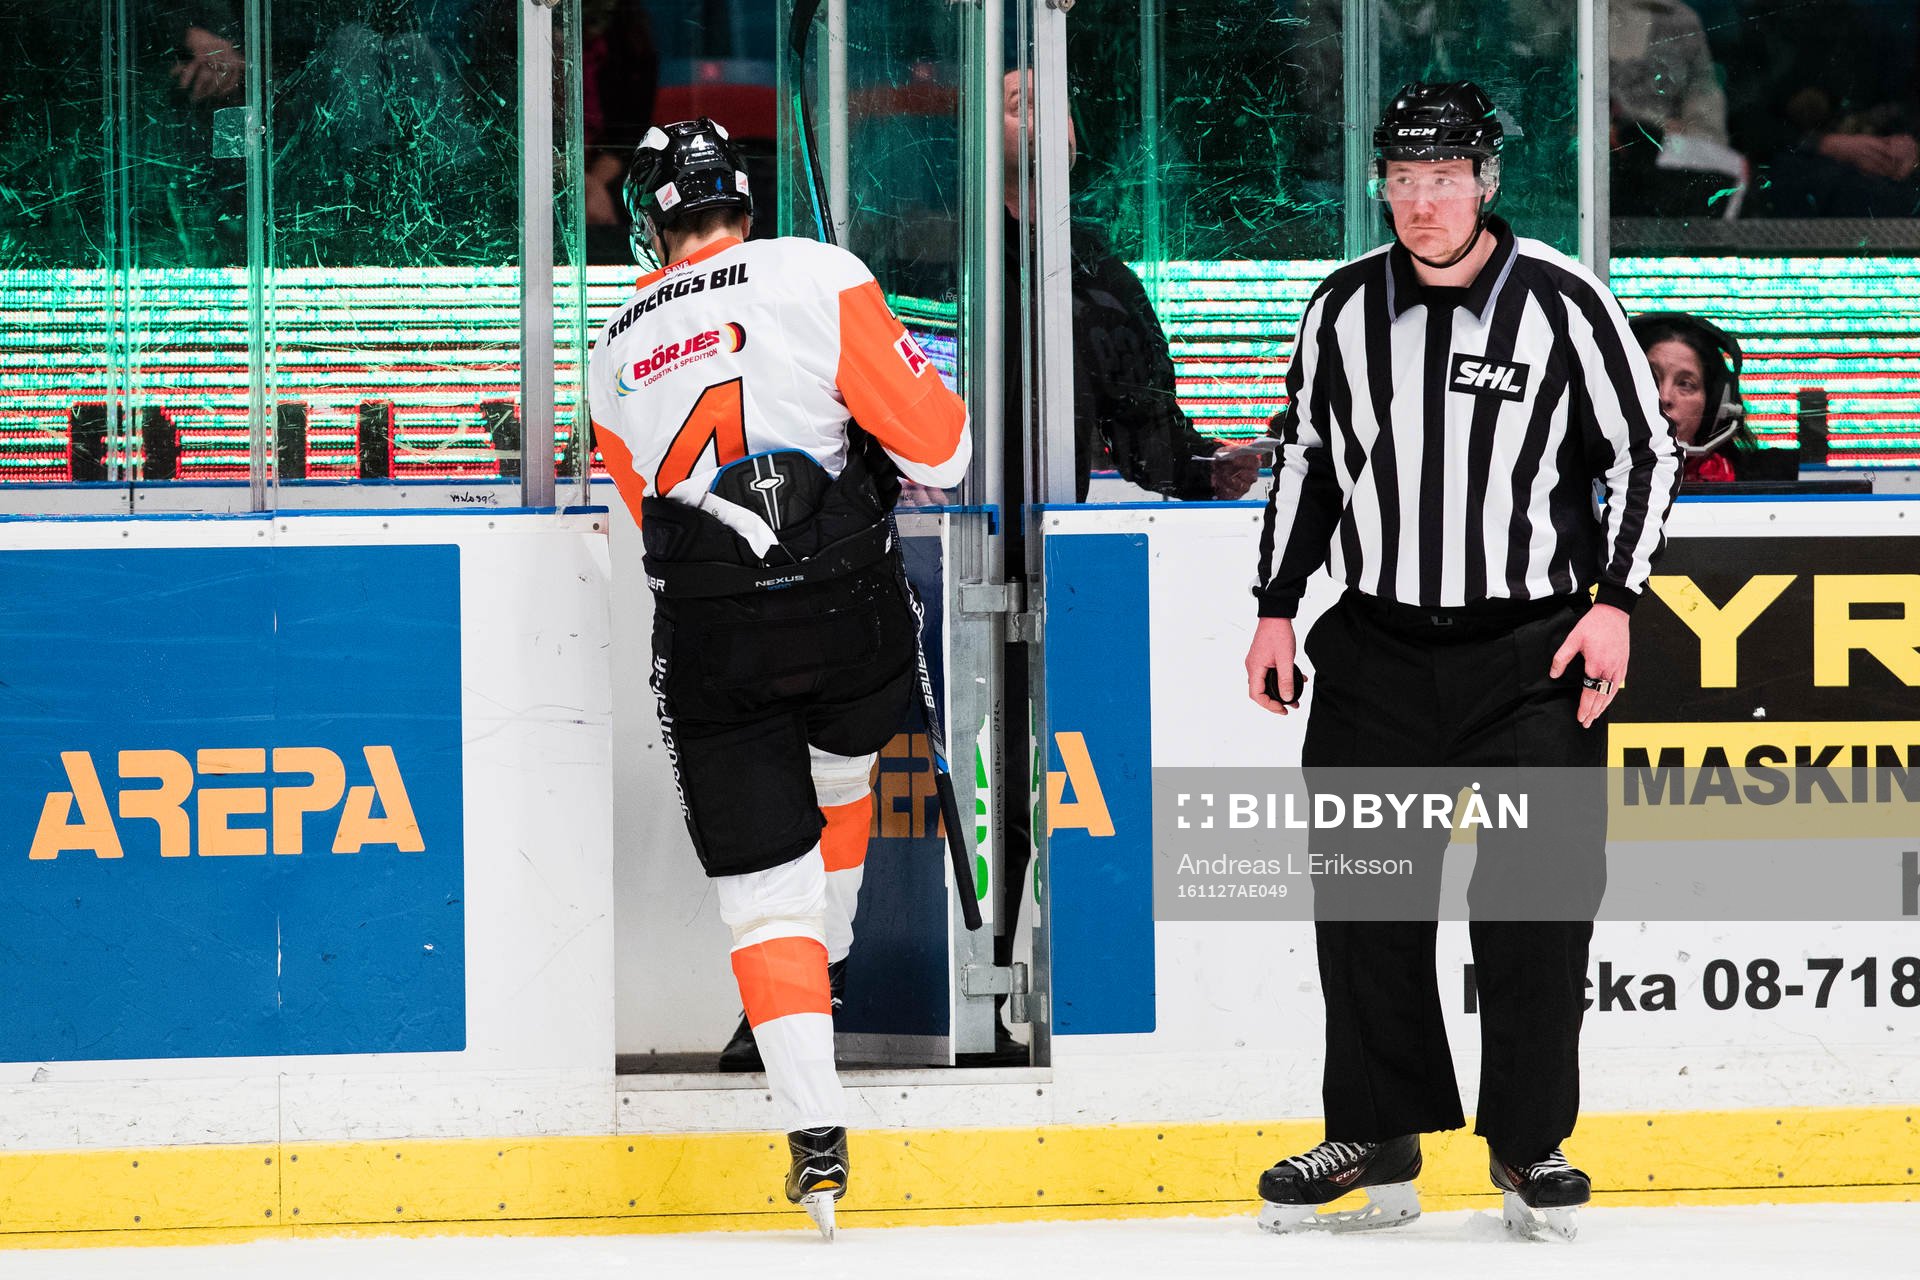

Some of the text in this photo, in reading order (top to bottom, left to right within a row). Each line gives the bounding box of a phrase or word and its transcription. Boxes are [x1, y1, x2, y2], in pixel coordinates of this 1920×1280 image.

[1397, 127, 1438, 137] CCM
[710, 263, 749, 290] BIL
[633, 330, 720, 381] BÖRJES
[643, 367, 672, 387] LOGISTIK
[680, 348, 718, 367] SPEDITION
[1454, 360, 1522, 393] SHL
[755, 574, 805, 588] NEXUS
[28, 745, 426, 860] AREPA
[1703, 956, 1920, 1011] 08-718
[1335, 1166, 1359, 1182] CCM
